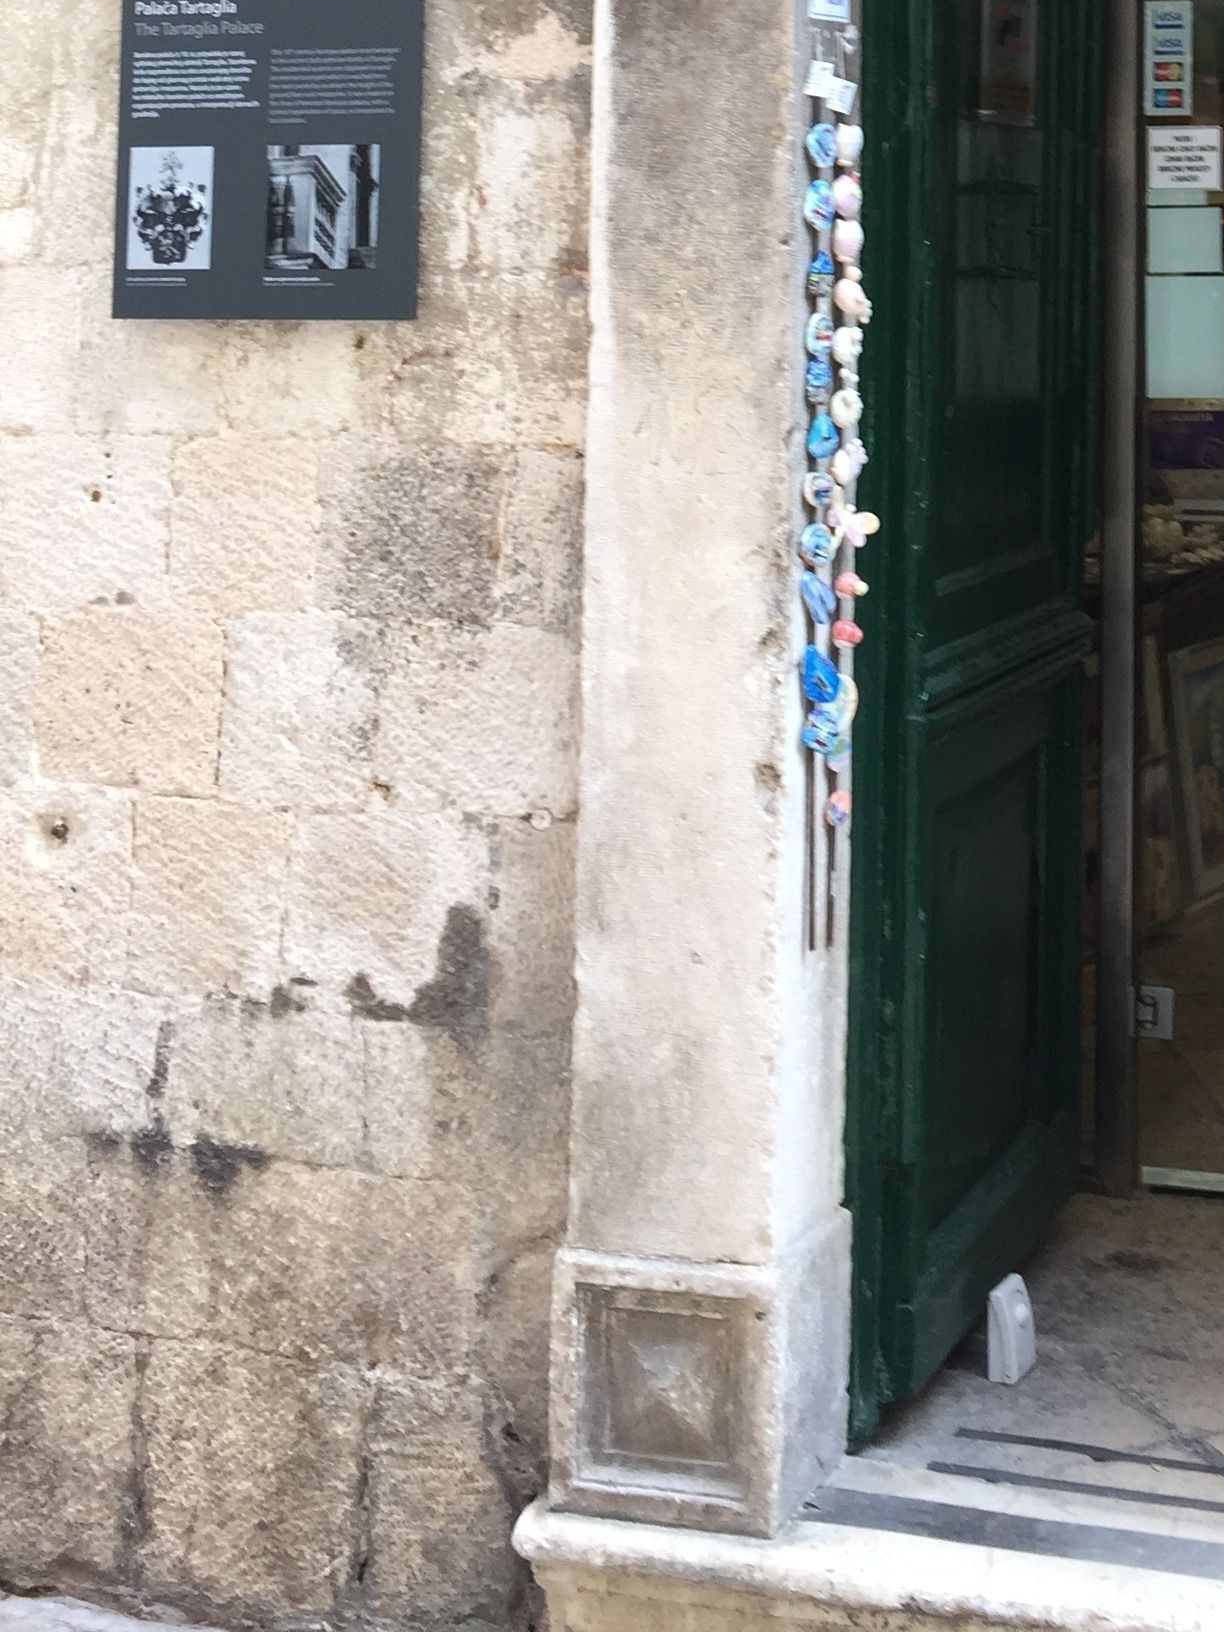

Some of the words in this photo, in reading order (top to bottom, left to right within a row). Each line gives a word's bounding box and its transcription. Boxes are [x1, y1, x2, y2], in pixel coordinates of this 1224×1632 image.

[134, 22, 160, 37] The
[161, 21, 219, 39] Tartaglia
[220, 20, 265, 35] Palace
